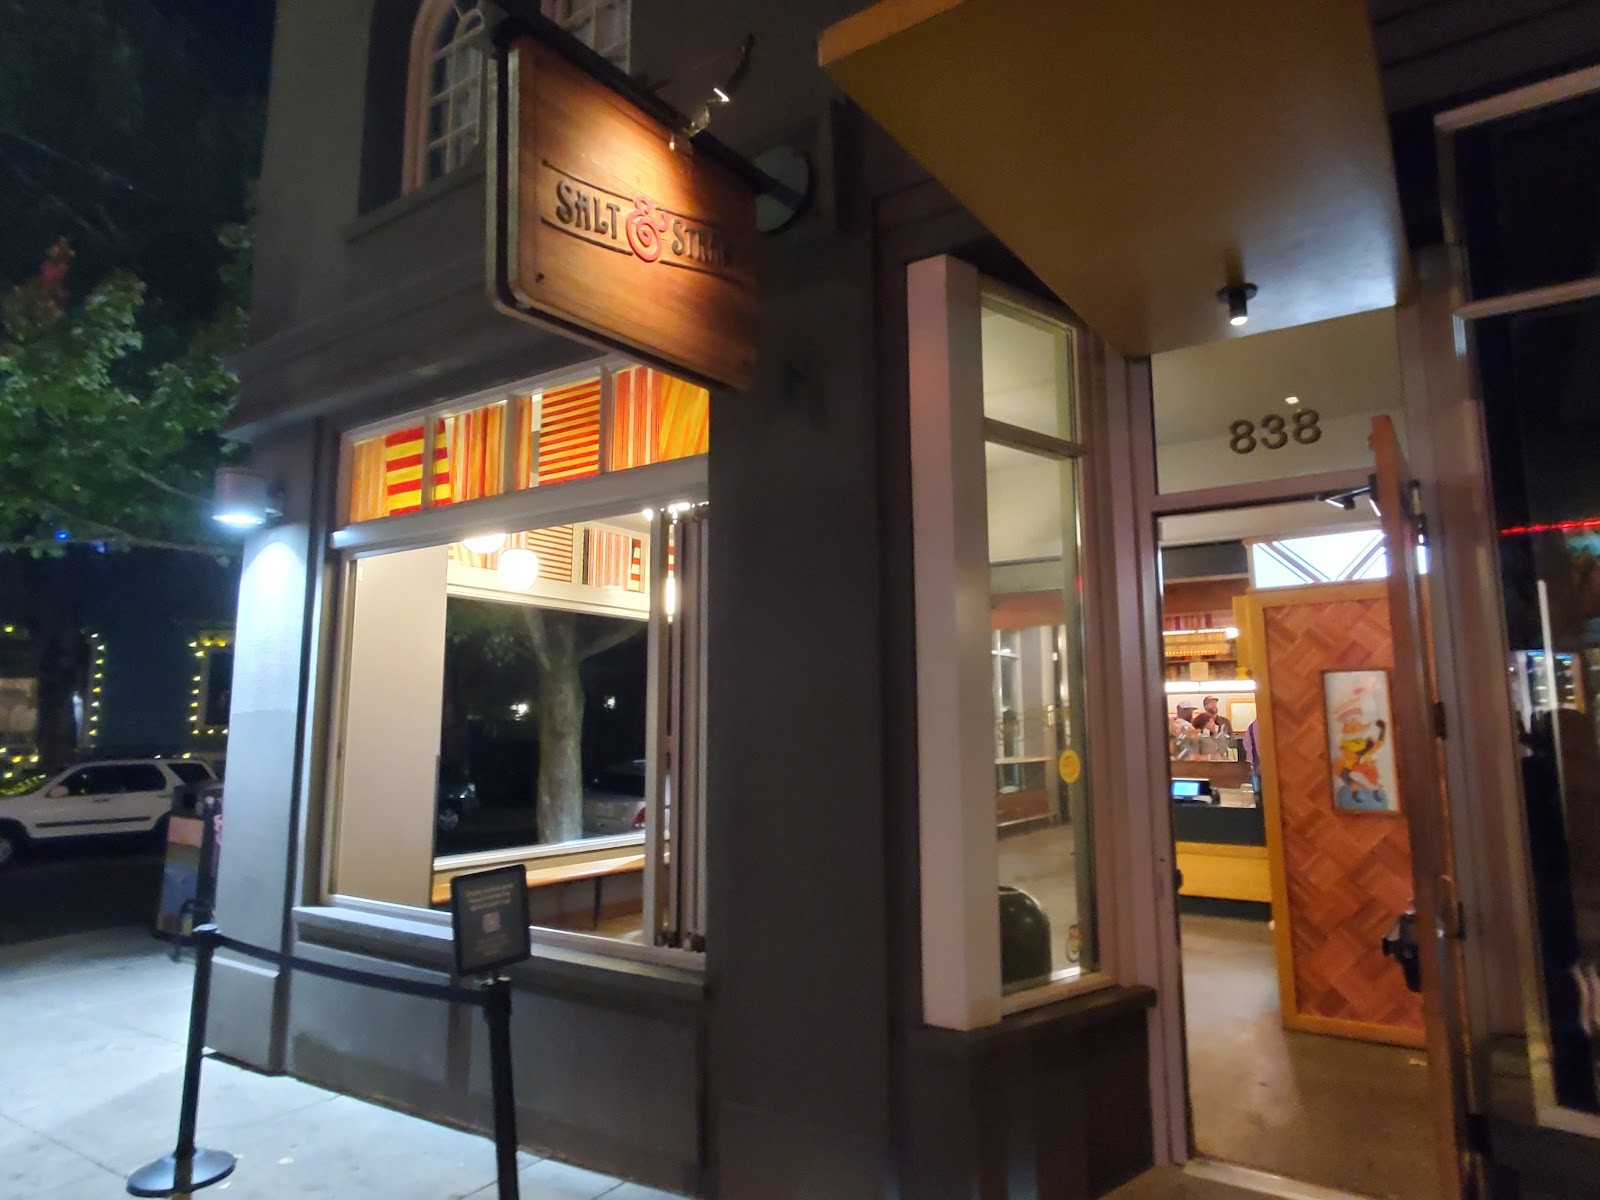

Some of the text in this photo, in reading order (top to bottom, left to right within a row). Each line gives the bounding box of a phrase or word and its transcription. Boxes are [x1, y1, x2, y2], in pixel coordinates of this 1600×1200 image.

[556, 181, 734, 268] SALT & STRA
[1229, 408, 1322, 454] 838
